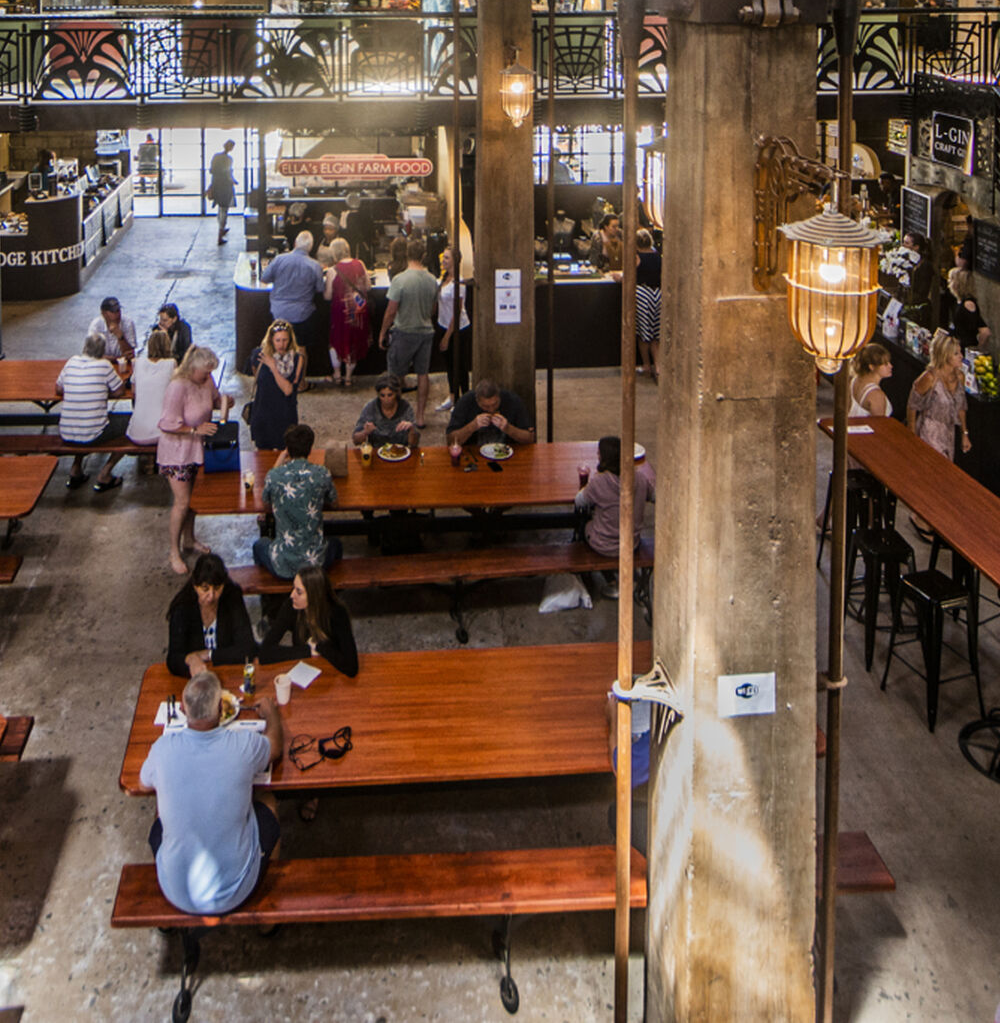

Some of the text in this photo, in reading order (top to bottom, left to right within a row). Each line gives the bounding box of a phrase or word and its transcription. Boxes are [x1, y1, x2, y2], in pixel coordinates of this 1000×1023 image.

[281, 162, 431, 174] ELLA's ELGIN FARM FOOD
